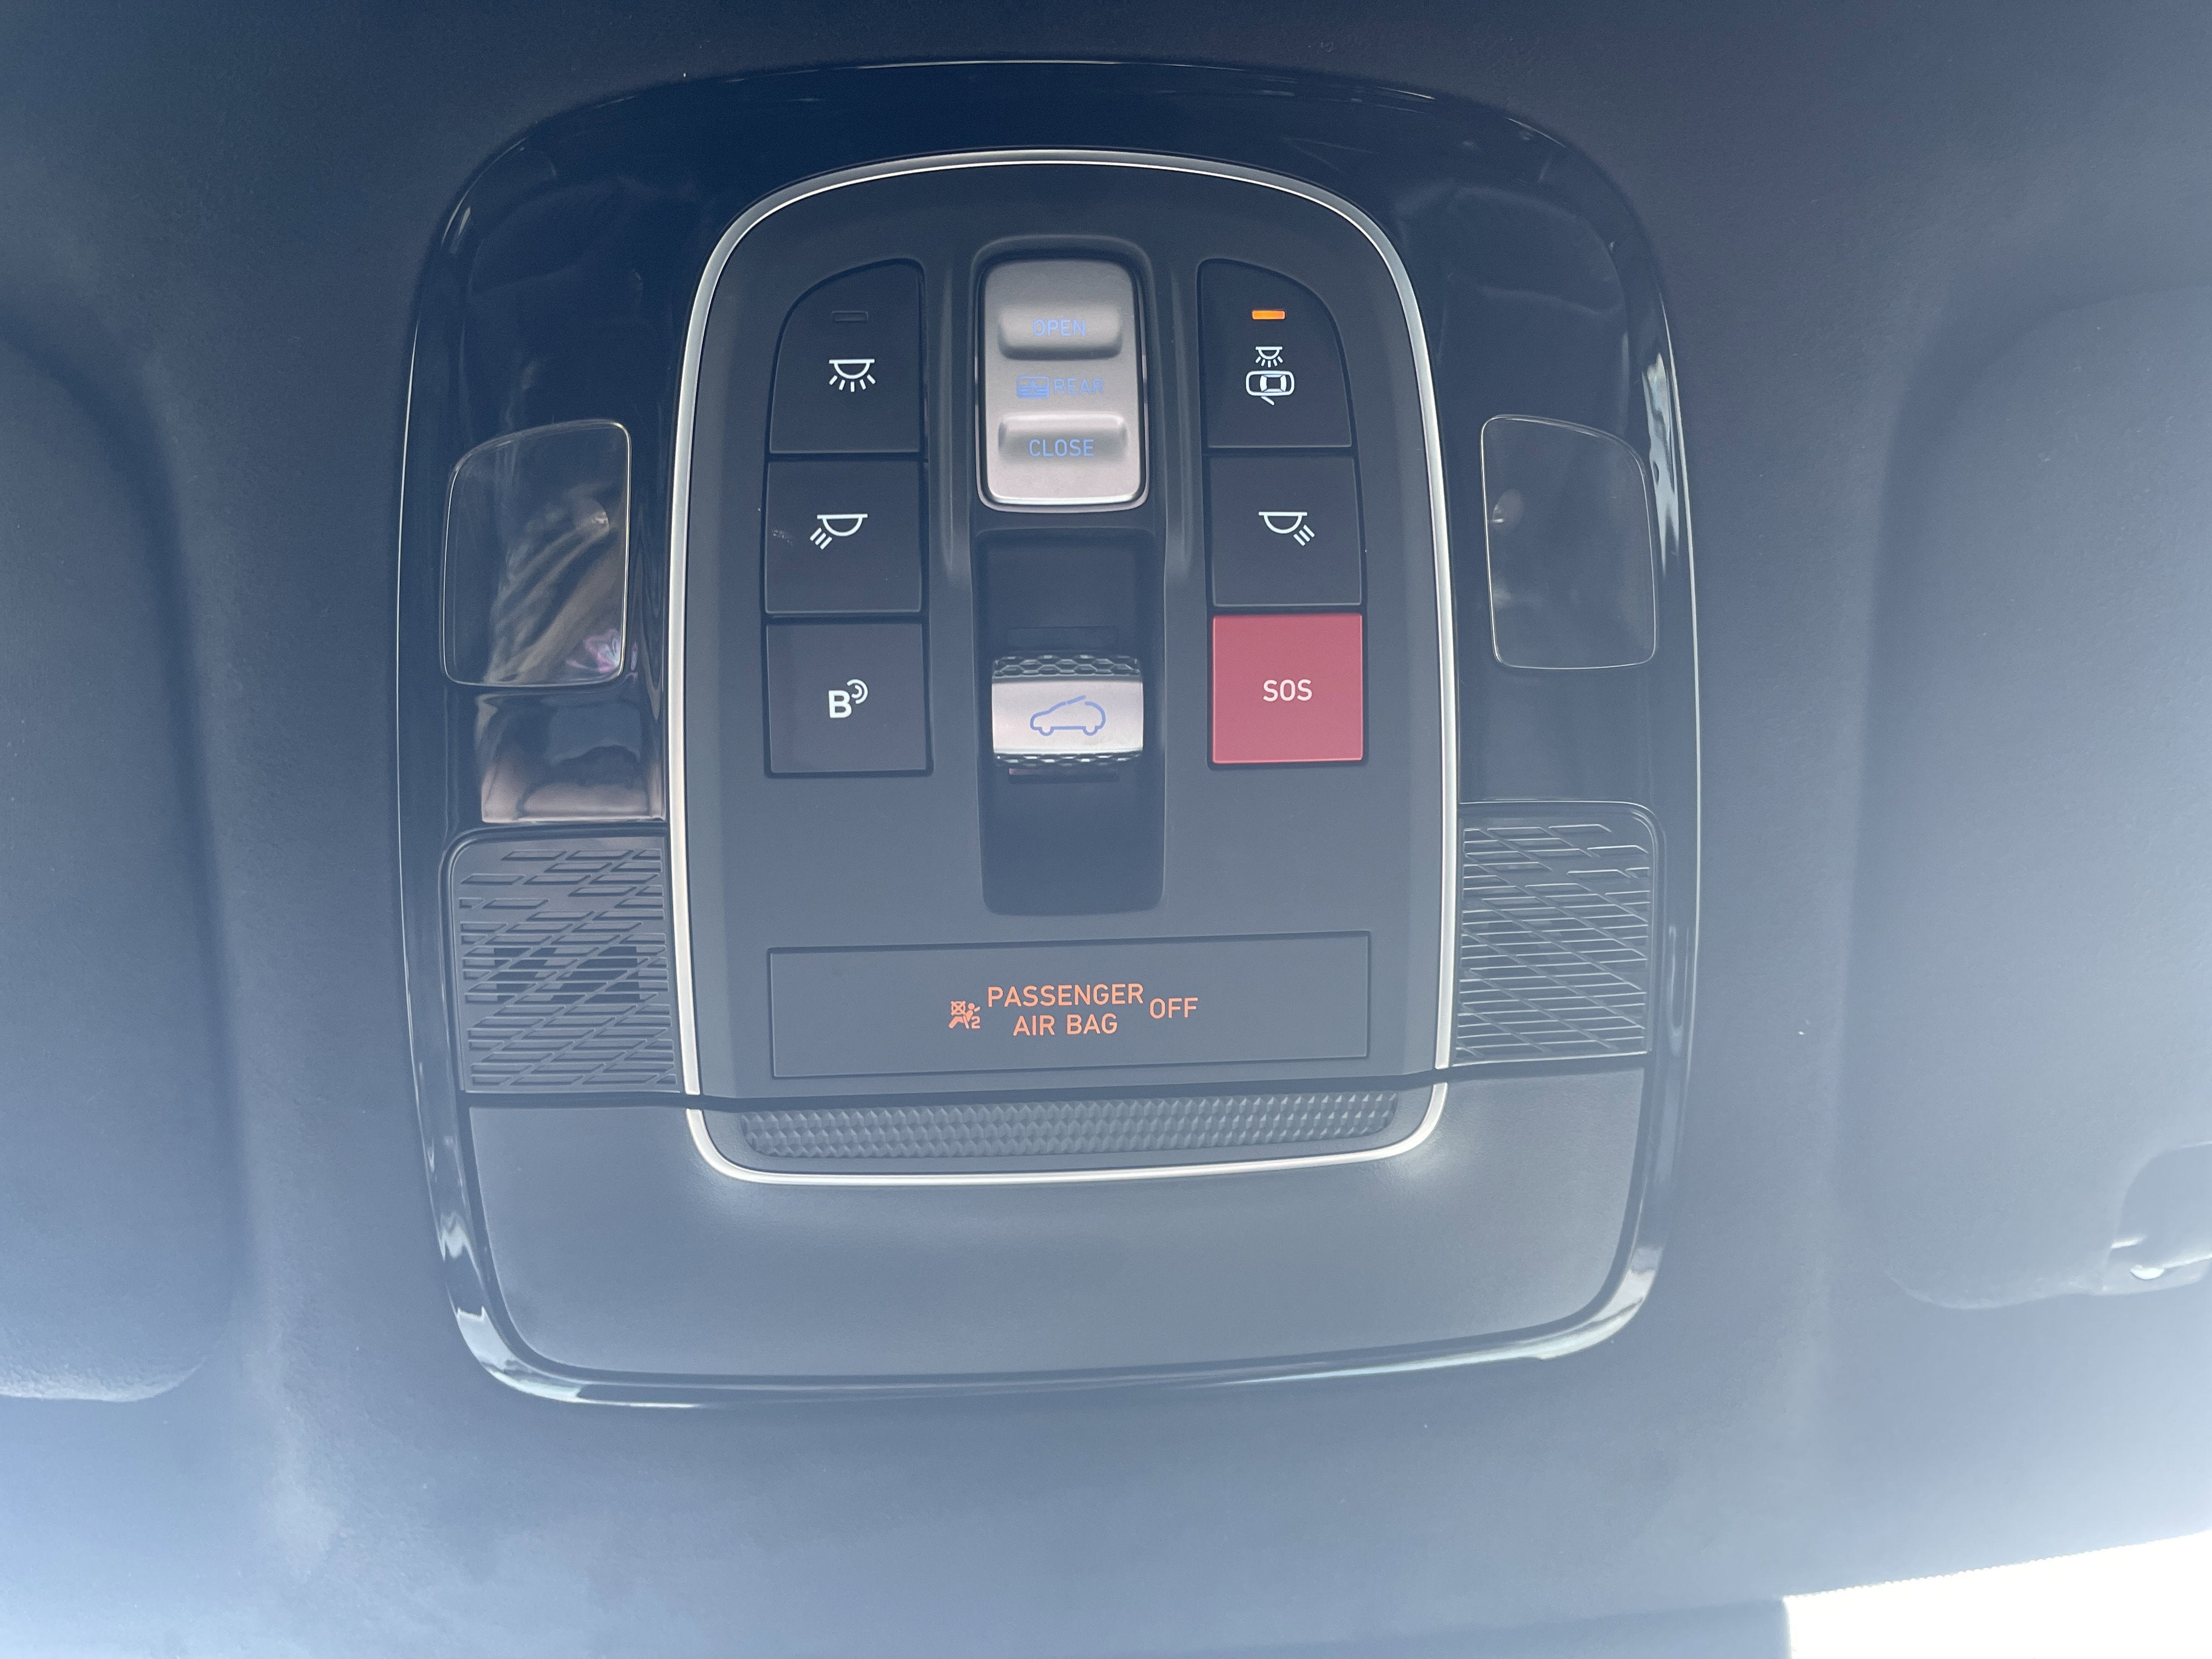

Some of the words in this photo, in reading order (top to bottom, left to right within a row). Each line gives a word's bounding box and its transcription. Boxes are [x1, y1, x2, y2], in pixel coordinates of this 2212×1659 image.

[1032, 319, 1086, 337] OPEN
[1053, 378, 1105, 396] REAR
[1029, 439, 1095, 458] CLOSE
[1263, 679, 1312, 702] SOS
[988, 983, 1144, 1008] PASSENGER
[1149, 997, 1199, 1019] OFF
[1013, 1015, 1056, 1036] AIR
[1066, 1013, 1118, 1035] BAG
